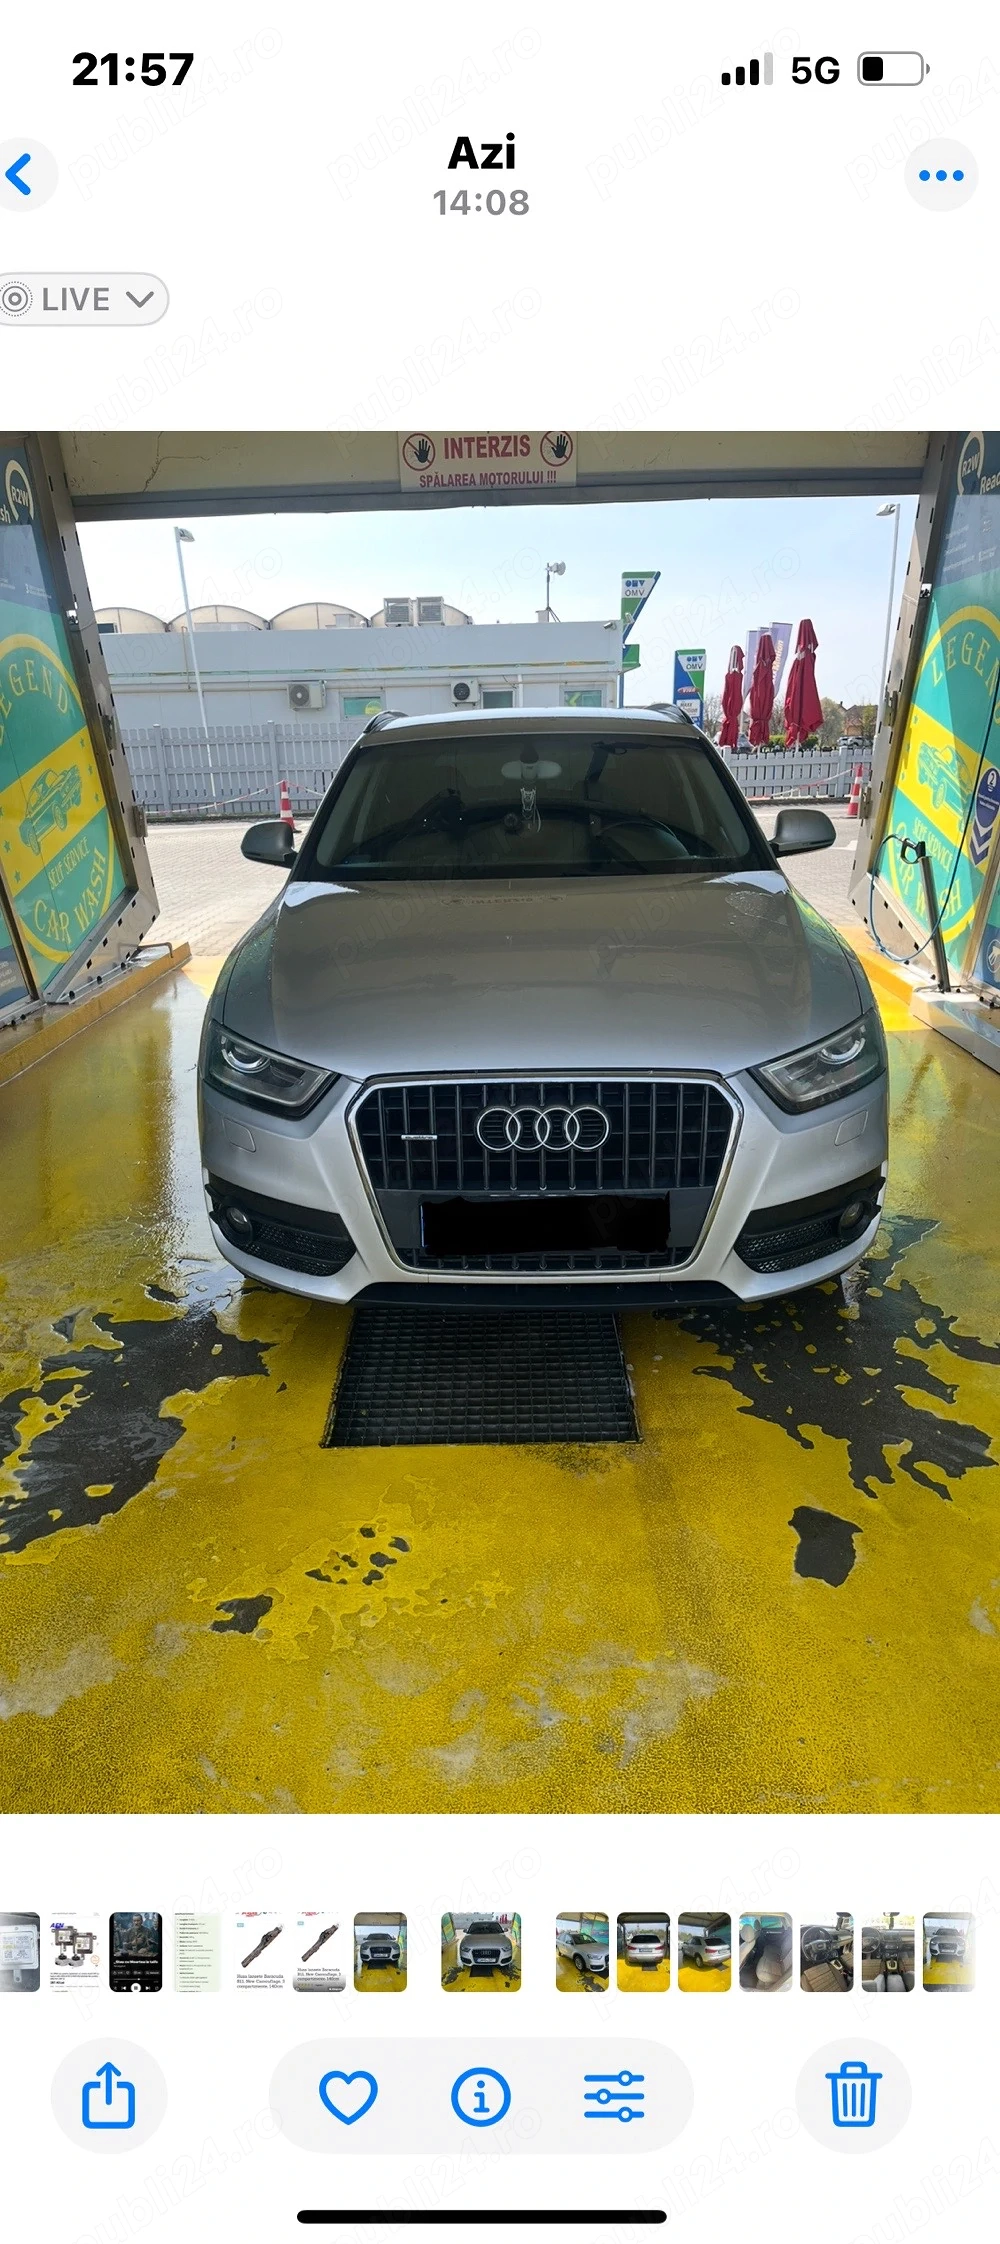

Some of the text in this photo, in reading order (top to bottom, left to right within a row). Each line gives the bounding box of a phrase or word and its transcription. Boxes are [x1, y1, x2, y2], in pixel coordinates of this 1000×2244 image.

[73, 52, 194, 86] 21:57
[792, 56, 840, 84] 5G
[448, 132, 515, 169] Azi
[434, 190, 529, 215] 14:08
[43, 288, 109, 310] LIVE
[444, 434, 530, 459] INTERZIS
[962, 453, 980, 477] R2W
[419, 470, 557, 488] SPĂLAREA MOTORULUI !!!
[11, 485, 29, 507] R2W
[624, 589, 645, 597] OMV
[48, 836, 90, 890] SELF SERVICE
[34, 846, 106, 945] CAR WASH
